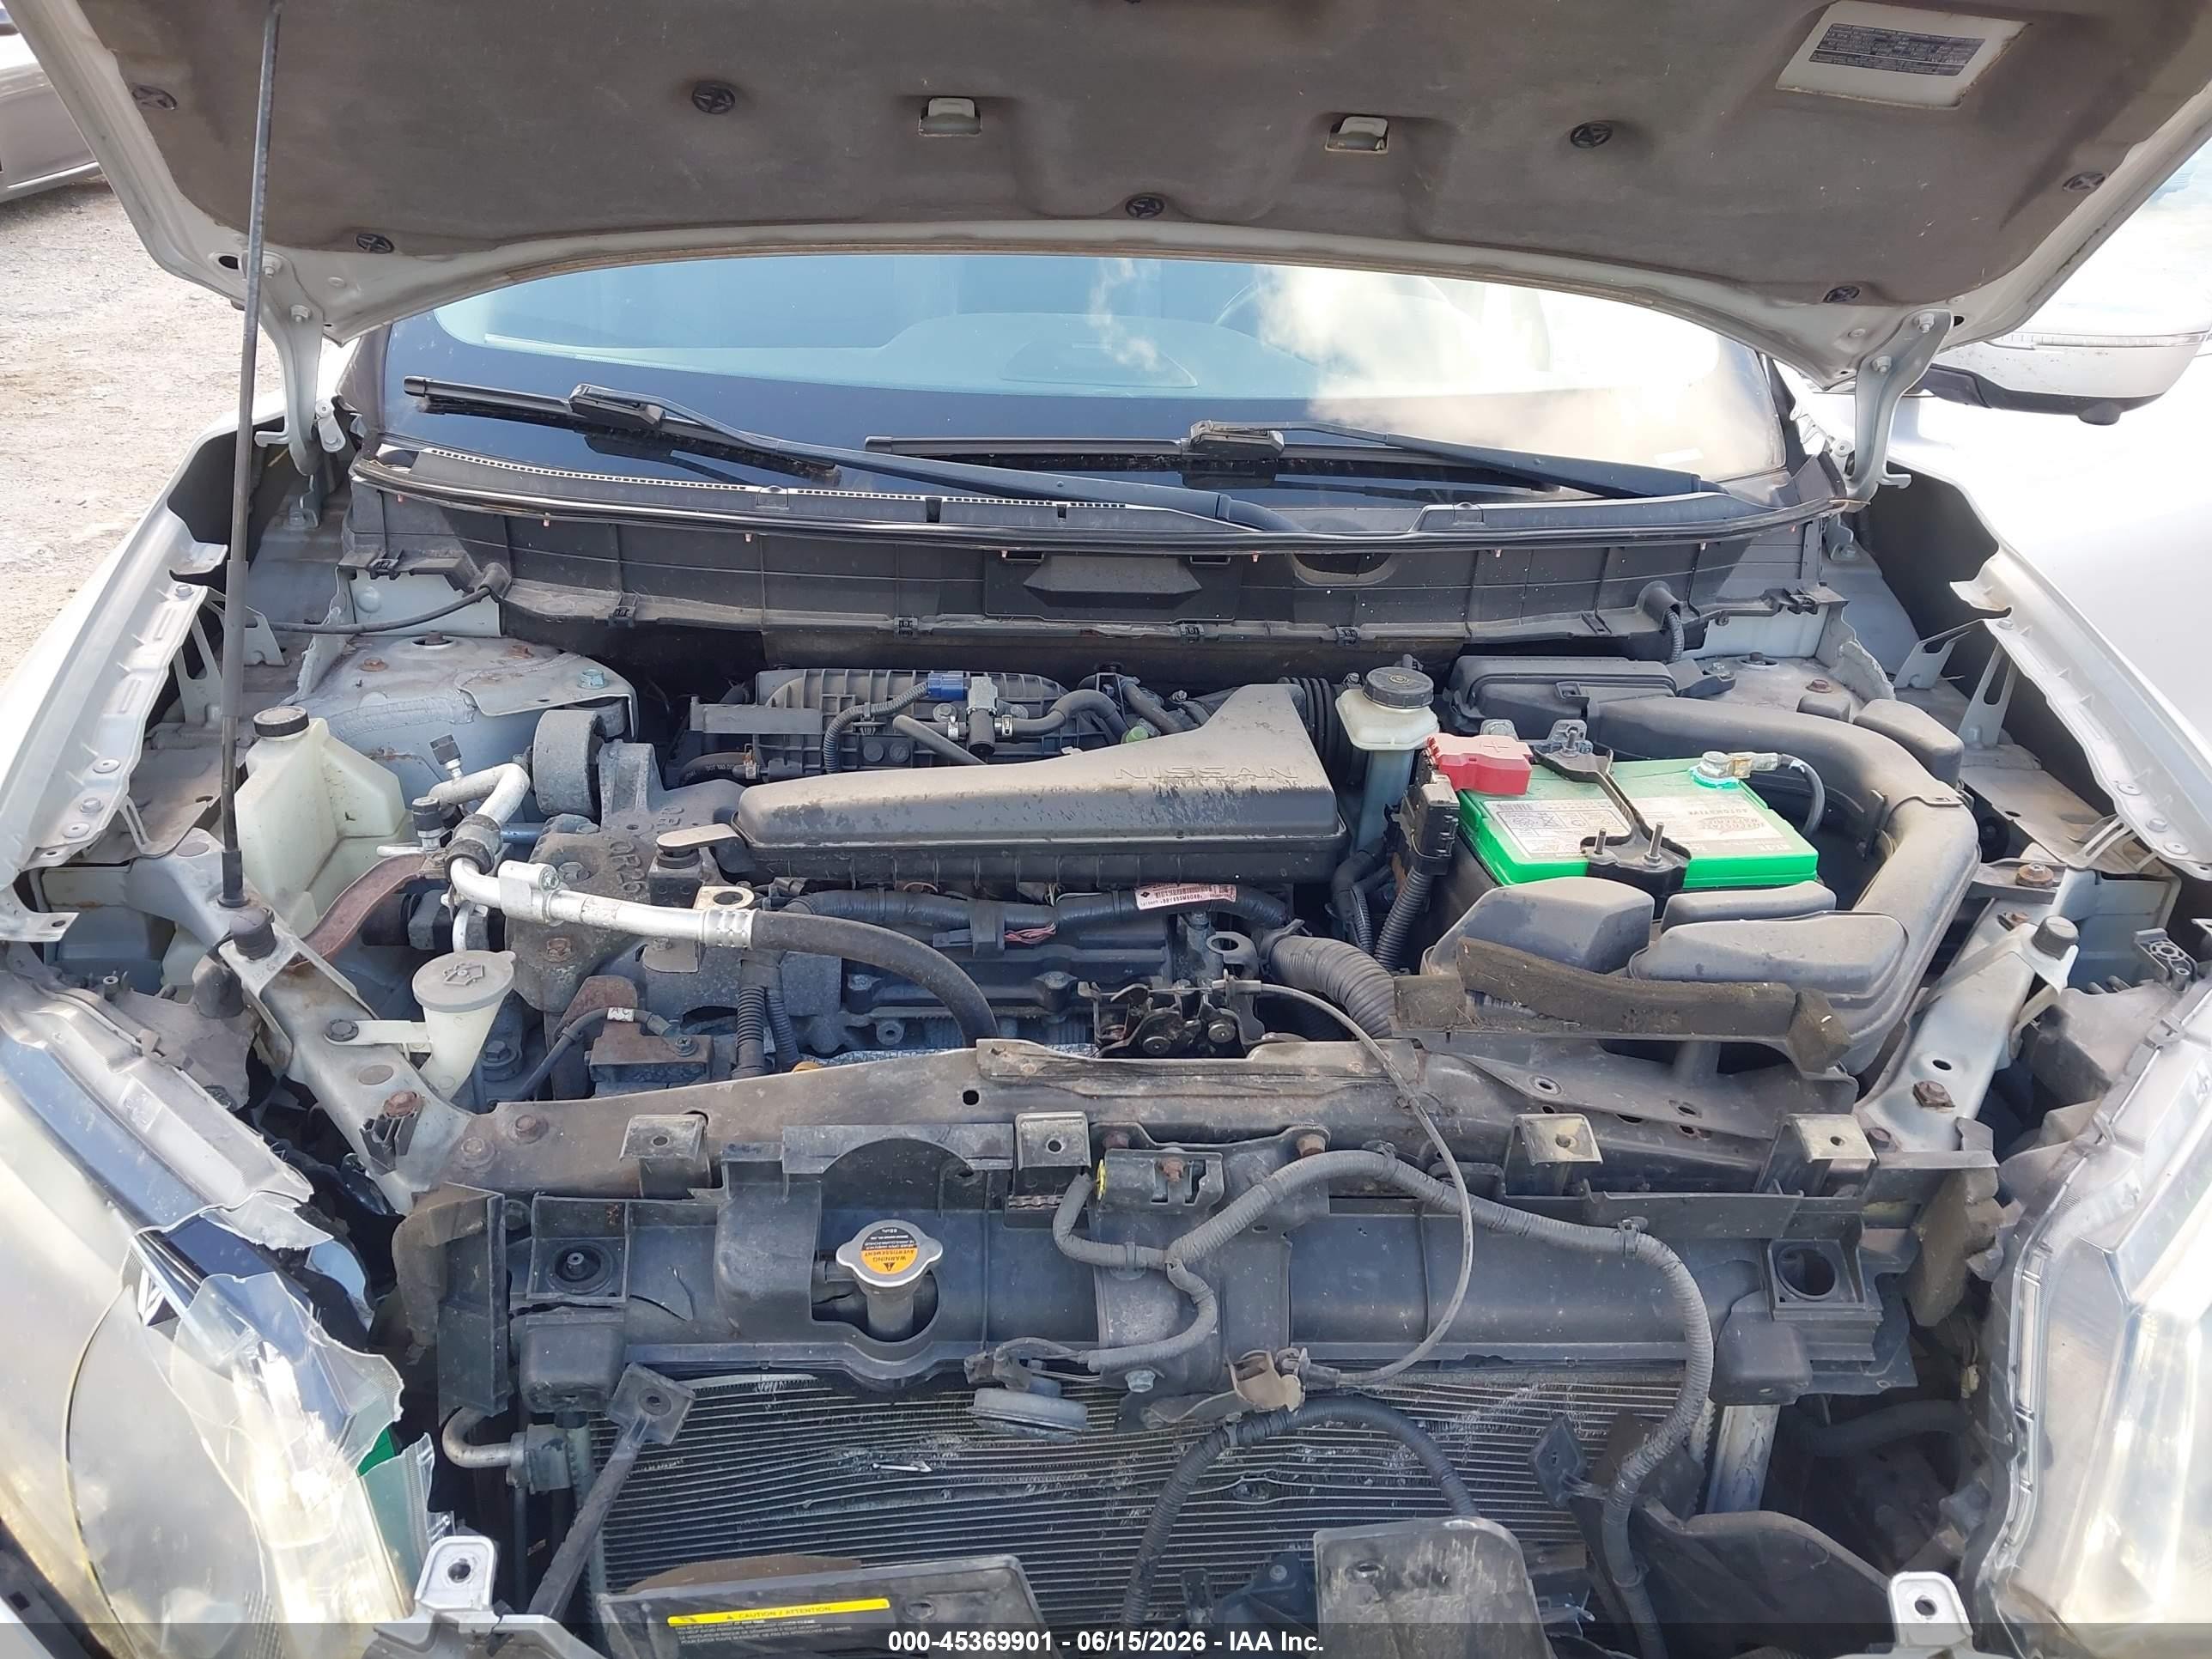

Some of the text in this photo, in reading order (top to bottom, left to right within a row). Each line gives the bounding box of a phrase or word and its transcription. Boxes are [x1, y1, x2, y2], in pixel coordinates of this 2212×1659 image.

[1113, 766, 1299, 779] NISSAN
[738, 1610, 776, 1620] CAUTION
[786, 1606, 831, 1616] ATTENTION
